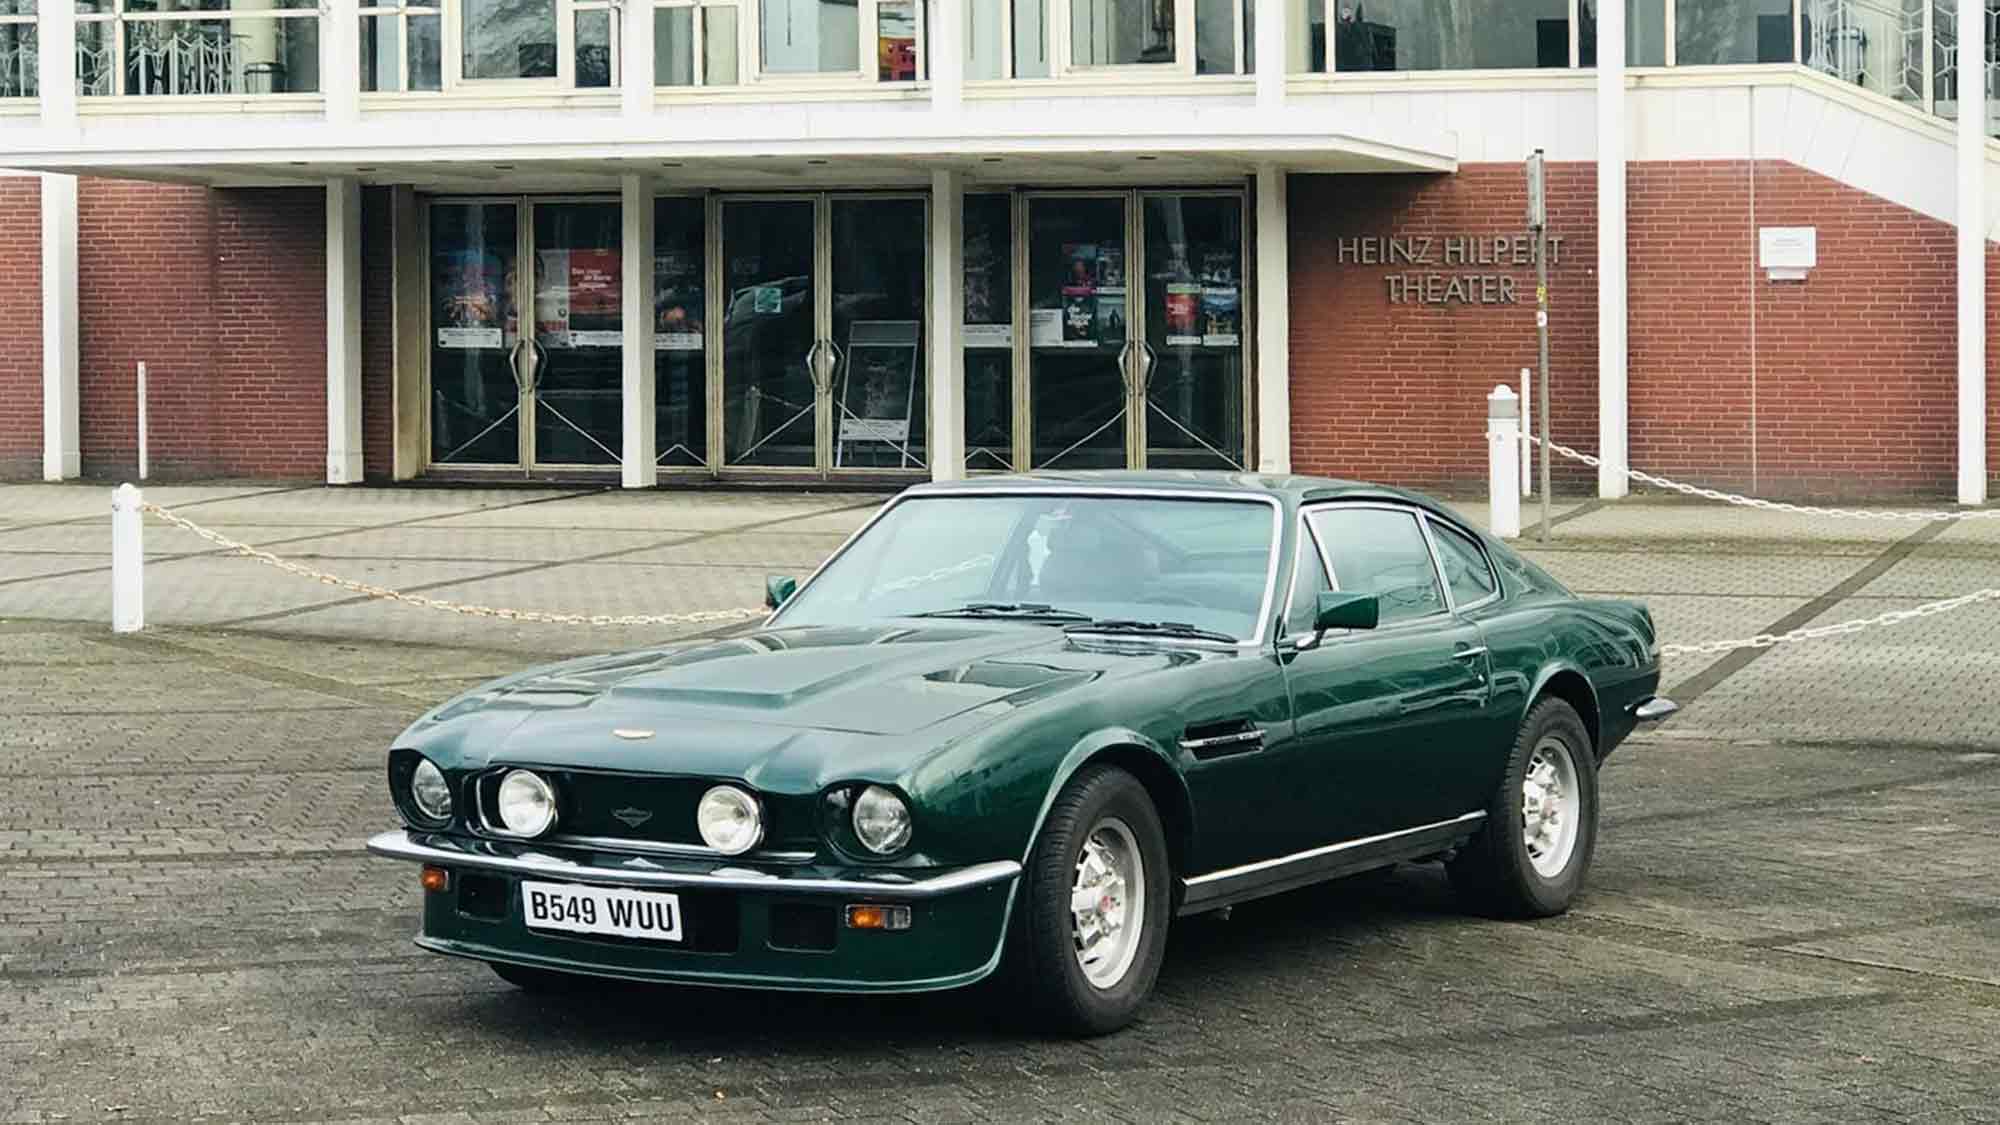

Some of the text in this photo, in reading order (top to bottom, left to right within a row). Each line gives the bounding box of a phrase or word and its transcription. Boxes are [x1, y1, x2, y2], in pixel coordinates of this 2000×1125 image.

[1338, 237, 1433, 264] HEINZ
[1385, 275, 1517, 302] THEATER
[531, 891, 674, 932] B549 WUU
